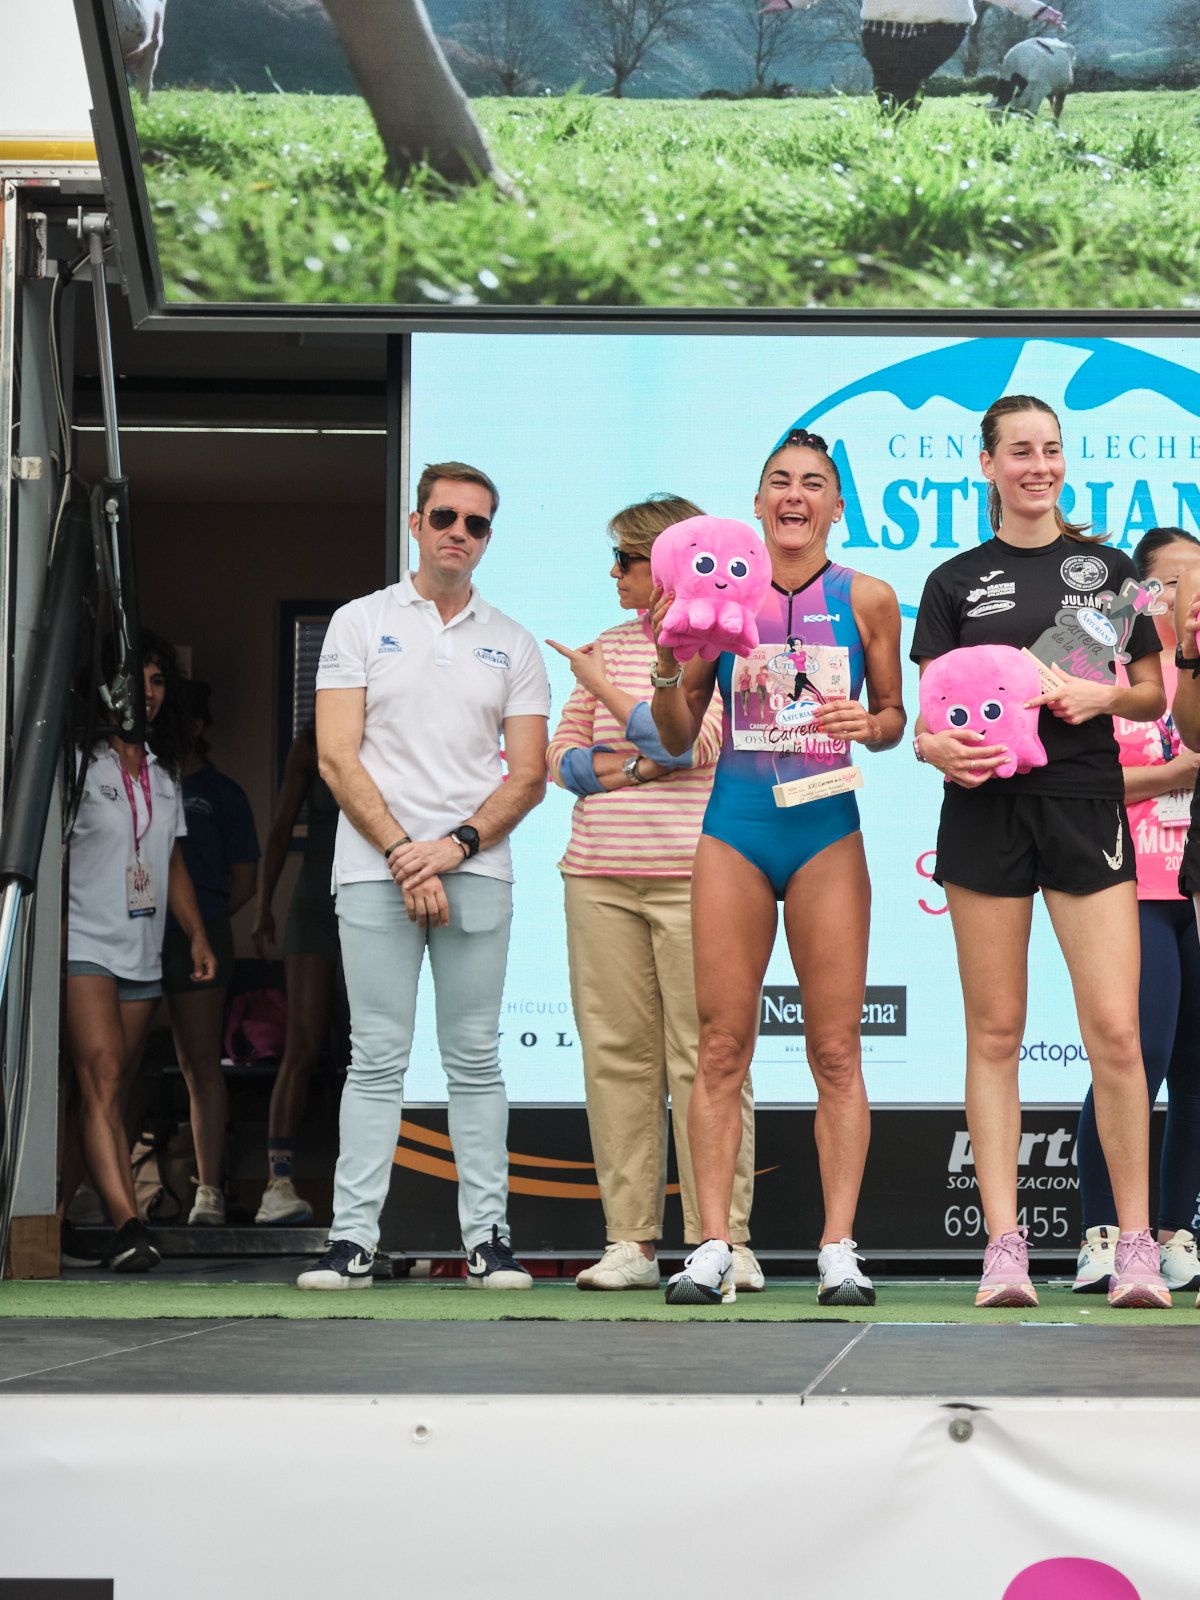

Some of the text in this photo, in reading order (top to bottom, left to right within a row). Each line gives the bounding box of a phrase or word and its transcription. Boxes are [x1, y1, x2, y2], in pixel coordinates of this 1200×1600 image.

[1061, 593, 1102, 609] JULIÁN
[1060, 614, 1103, 656] Carrera
[1019, 1041, 1089, 1067] octopu
